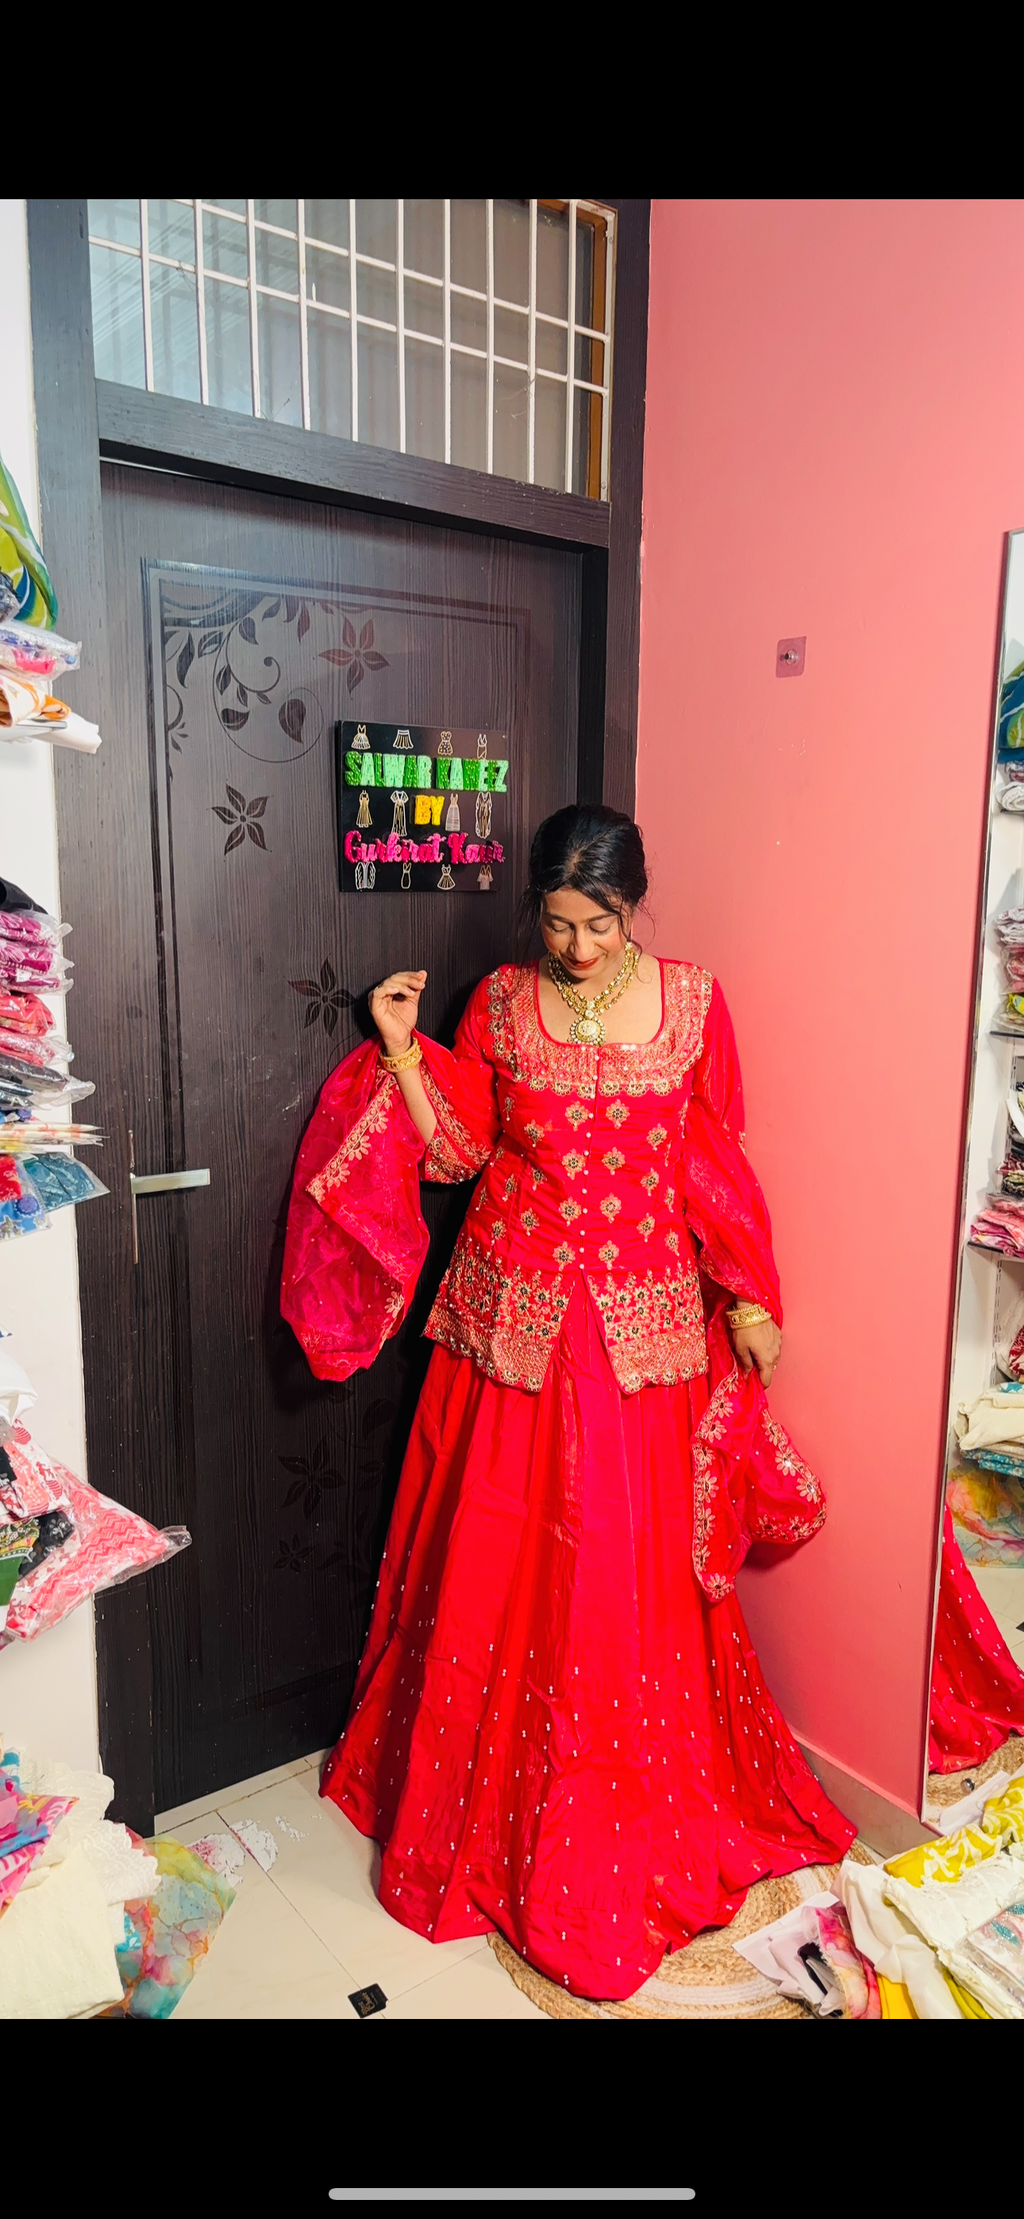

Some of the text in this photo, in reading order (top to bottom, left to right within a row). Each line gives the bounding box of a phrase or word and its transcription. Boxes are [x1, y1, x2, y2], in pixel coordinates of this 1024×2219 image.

[344, 750, 509, 793] SALWAR KAMEEZ
[414, 794, 445, 826] BY
[344, 830, 506, 865] Gurkirat Kaur
